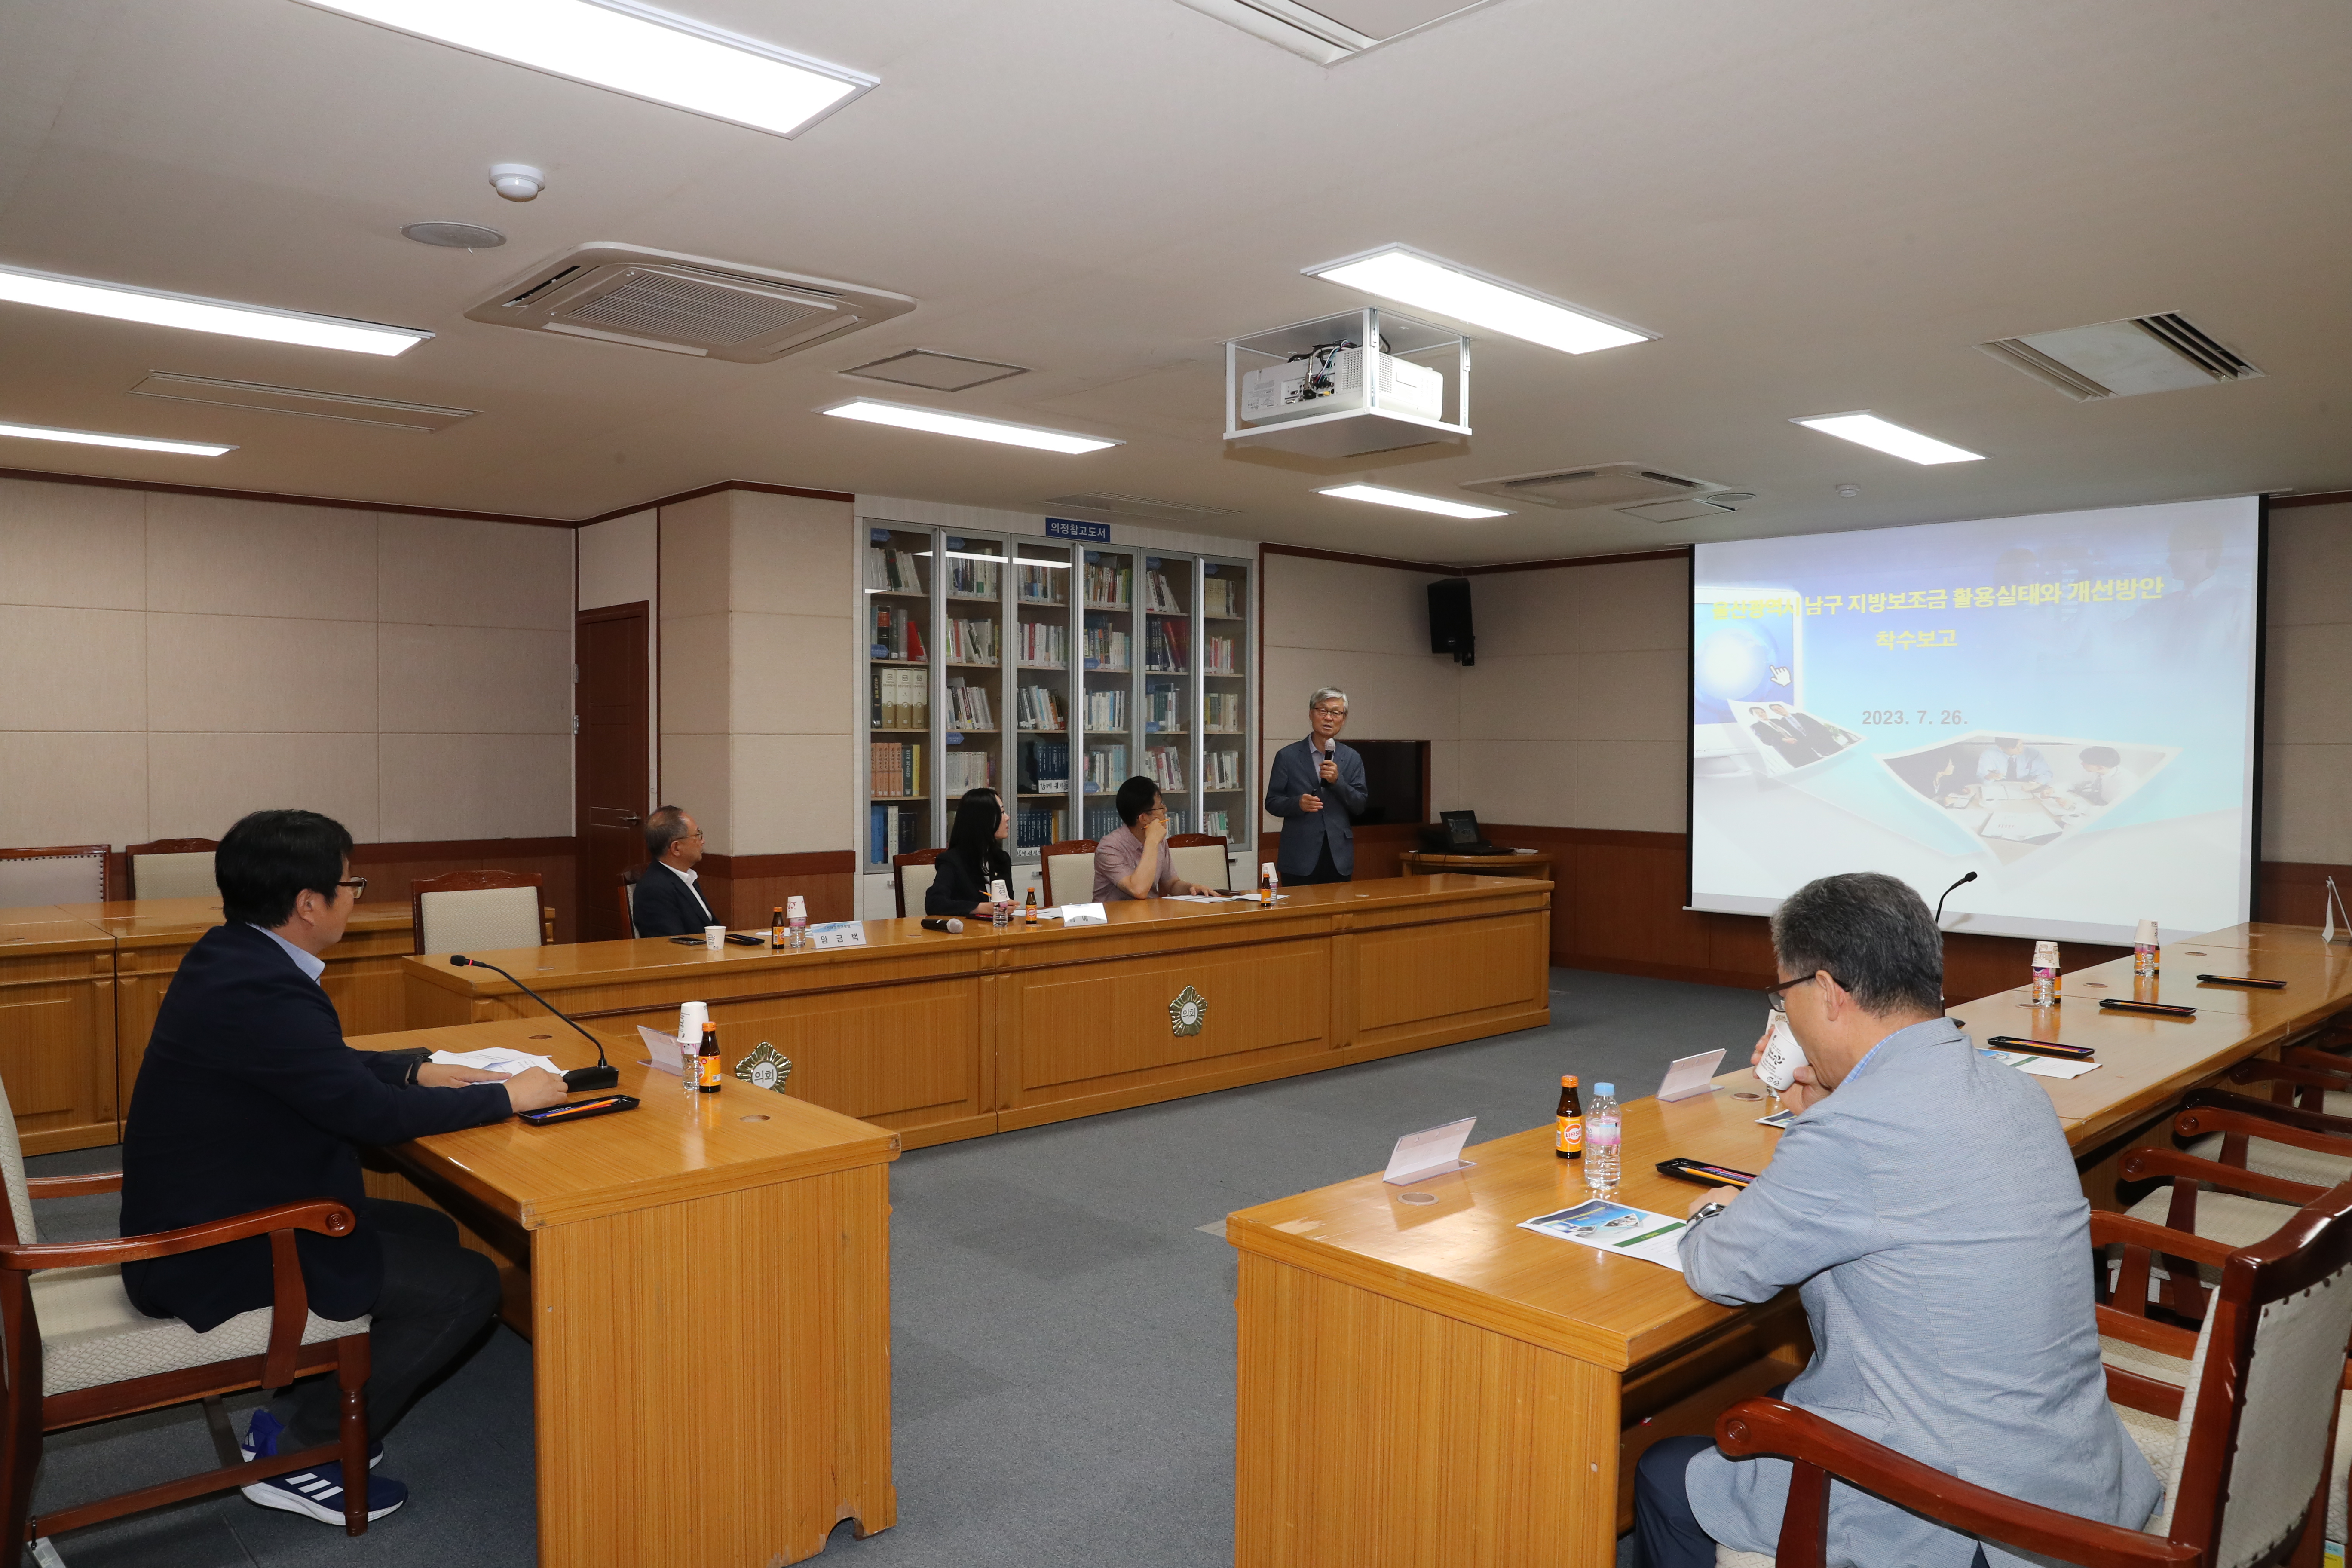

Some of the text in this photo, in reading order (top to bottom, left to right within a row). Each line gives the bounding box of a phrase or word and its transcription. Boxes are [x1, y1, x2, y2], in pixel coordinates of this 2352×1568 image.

[1050, 522, 1106, 539] 의정참고도서
[1712, 576, 2165, 620] 울산광역시 남구 지방보조금 활용실태와 개선방안
[1875, 629, 1958, 651] 착수보고
[1862, 710, 1968, 725] 2023. 7. 26.
[1182, 1008, 1196, 1019] 의회
[754, 1069, 774, 1083] 의회
[1565, 1129, 1582, 1138] 비타500
